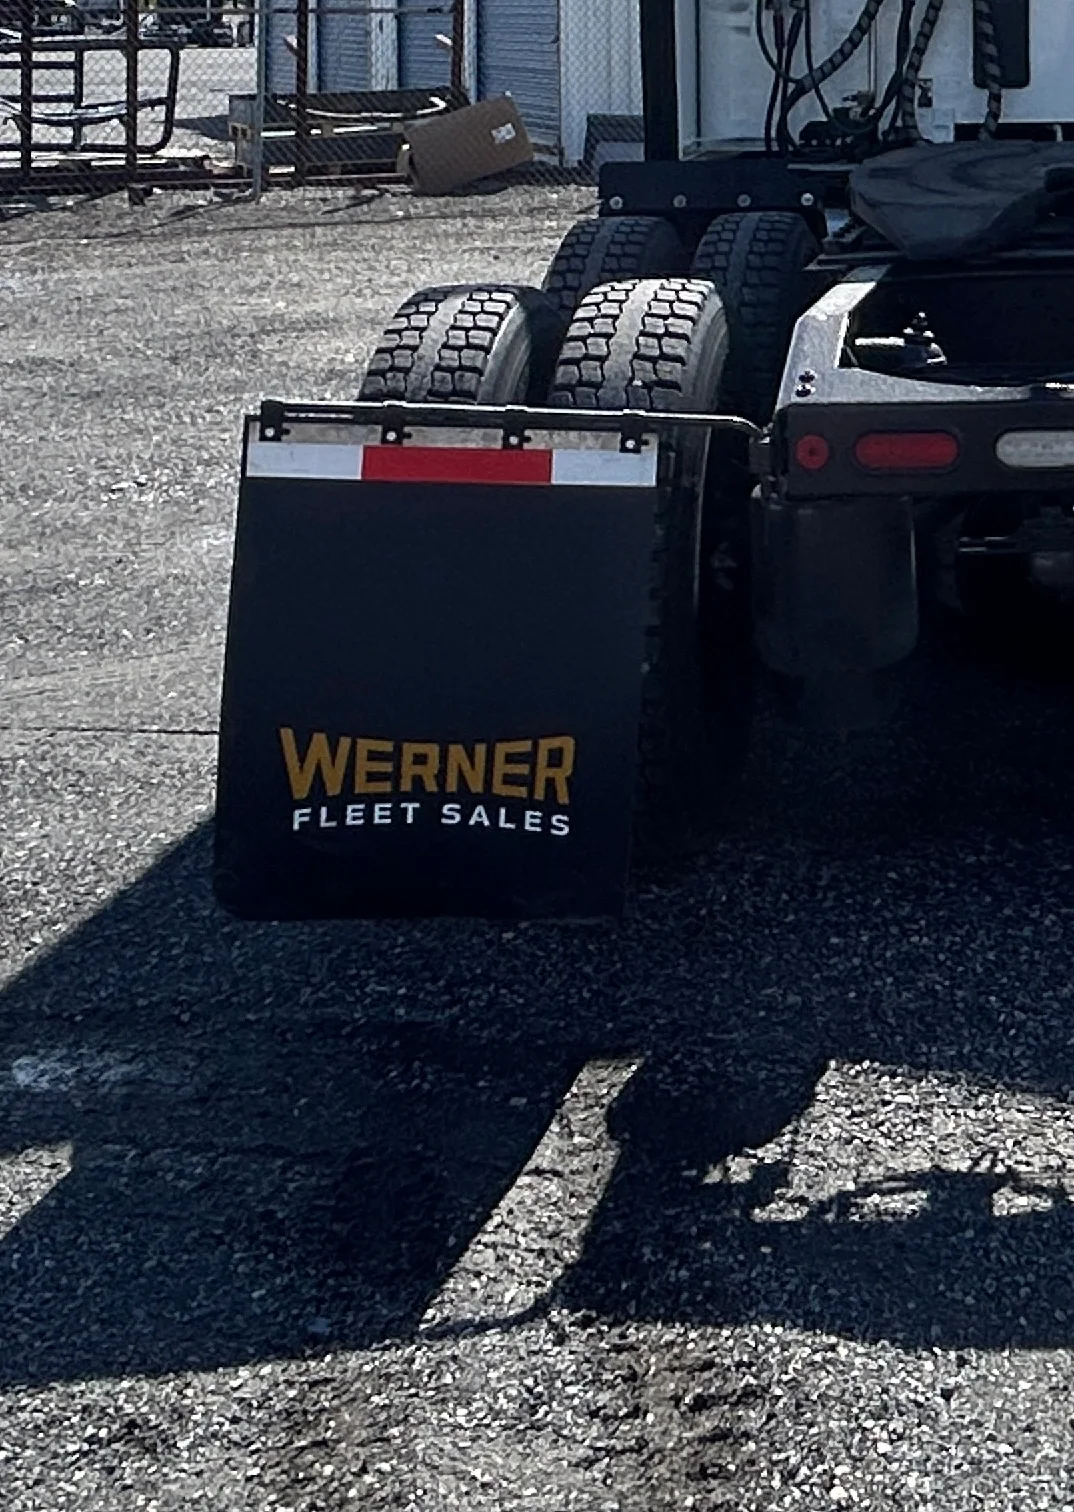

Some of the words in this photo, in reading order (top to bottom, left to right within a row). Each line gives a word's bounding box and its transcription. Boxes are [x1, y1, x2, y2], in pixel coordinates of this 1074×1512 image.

[279, 727, 576, 805] WERNER
[291, 802, 420, 832] FLEET
[440, 803, 570, 836] SALES
